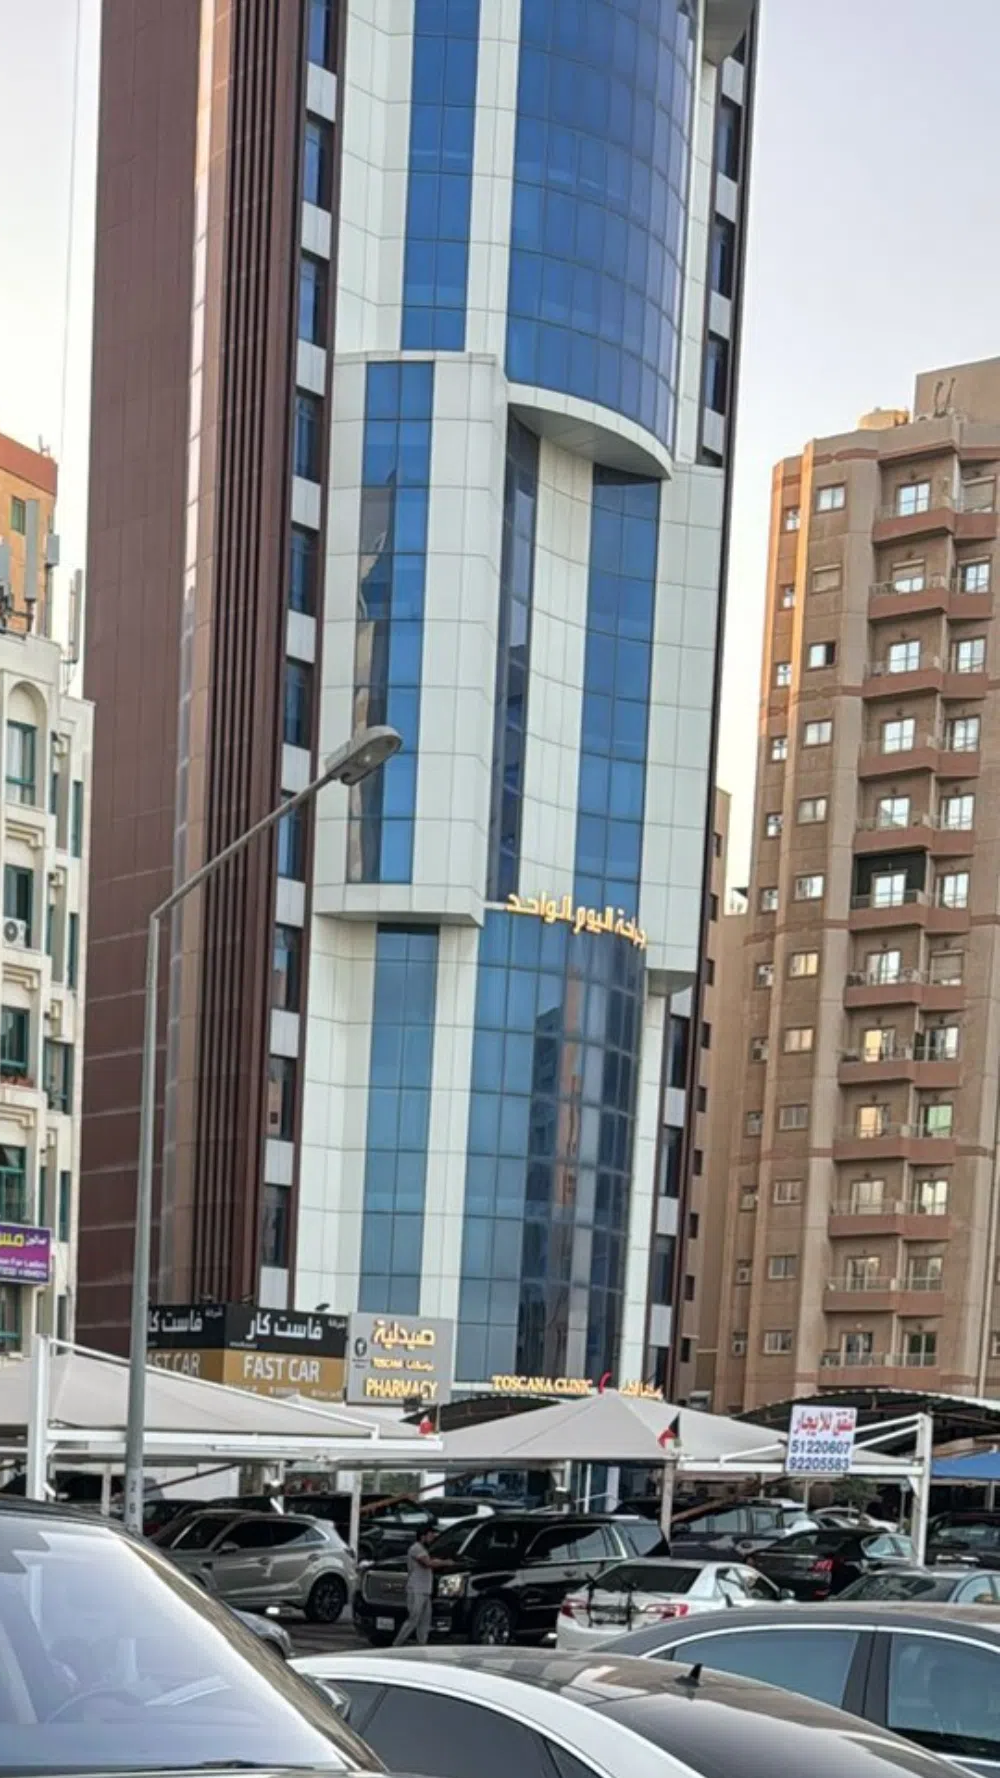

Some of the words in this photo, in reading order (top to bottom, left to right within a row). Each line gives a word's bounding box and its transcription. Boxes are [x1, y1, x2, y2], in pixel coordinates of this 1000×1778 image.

[505, 891, 573, 924] الواحد
[573, 906, 614, 935] اليوم
[147, 1310, 160, 1333] كا
[161, 1309, 203, 1333] فاست
[244, 1311, 271, 1341] كار
[274, 1316, 323, 1340] فاست
[373, 1319, 436, 1349] صيدلية
[244, 1355, 285, 1381] FAST
[288, 1358, 320, 1383] CAR
[366, 1377, 438, 1400] PHARMACY
[492, 1375, 552, 1393] TOSCANA
[554, 1377, 593, 1394] CLINIC
[791, 1439, 850, 1454] 51220607
[789, 1456, 849, 1471] 92205583
